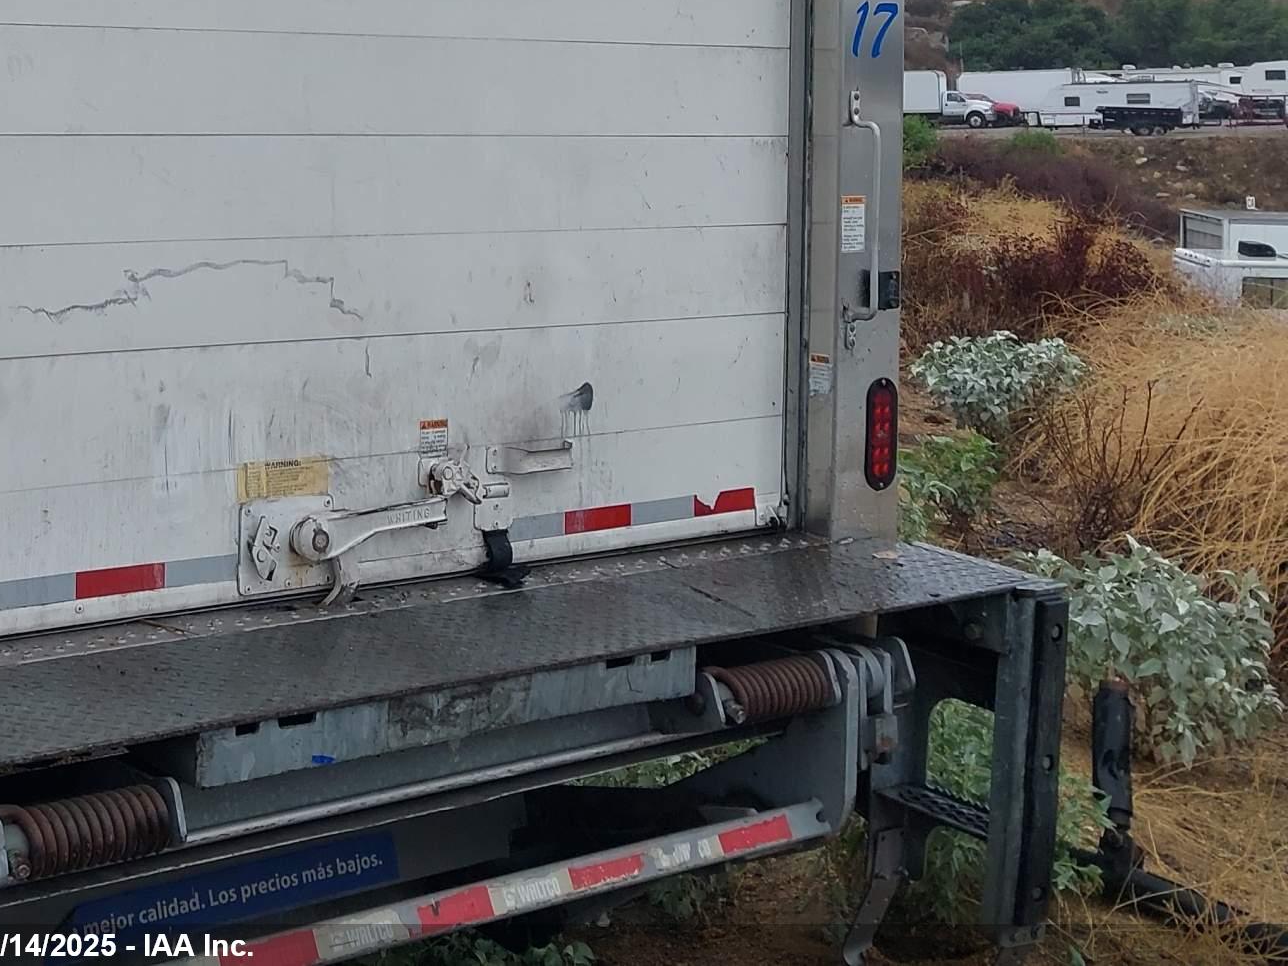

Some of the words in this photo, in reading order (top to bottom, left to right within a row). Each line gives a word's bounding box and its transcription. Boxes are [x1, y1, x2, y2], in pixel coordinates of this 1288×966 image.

[852, 0, 899, 59] 17
[385, 506, 431, 523] WHITING
[139, 892, 206, 924] calidad.
[209, 888, 237, 908] Los
[240, 873, 299, 903] precios
[302, 862, 334, 884] más
[336, 853, 383, 876] bajos.
